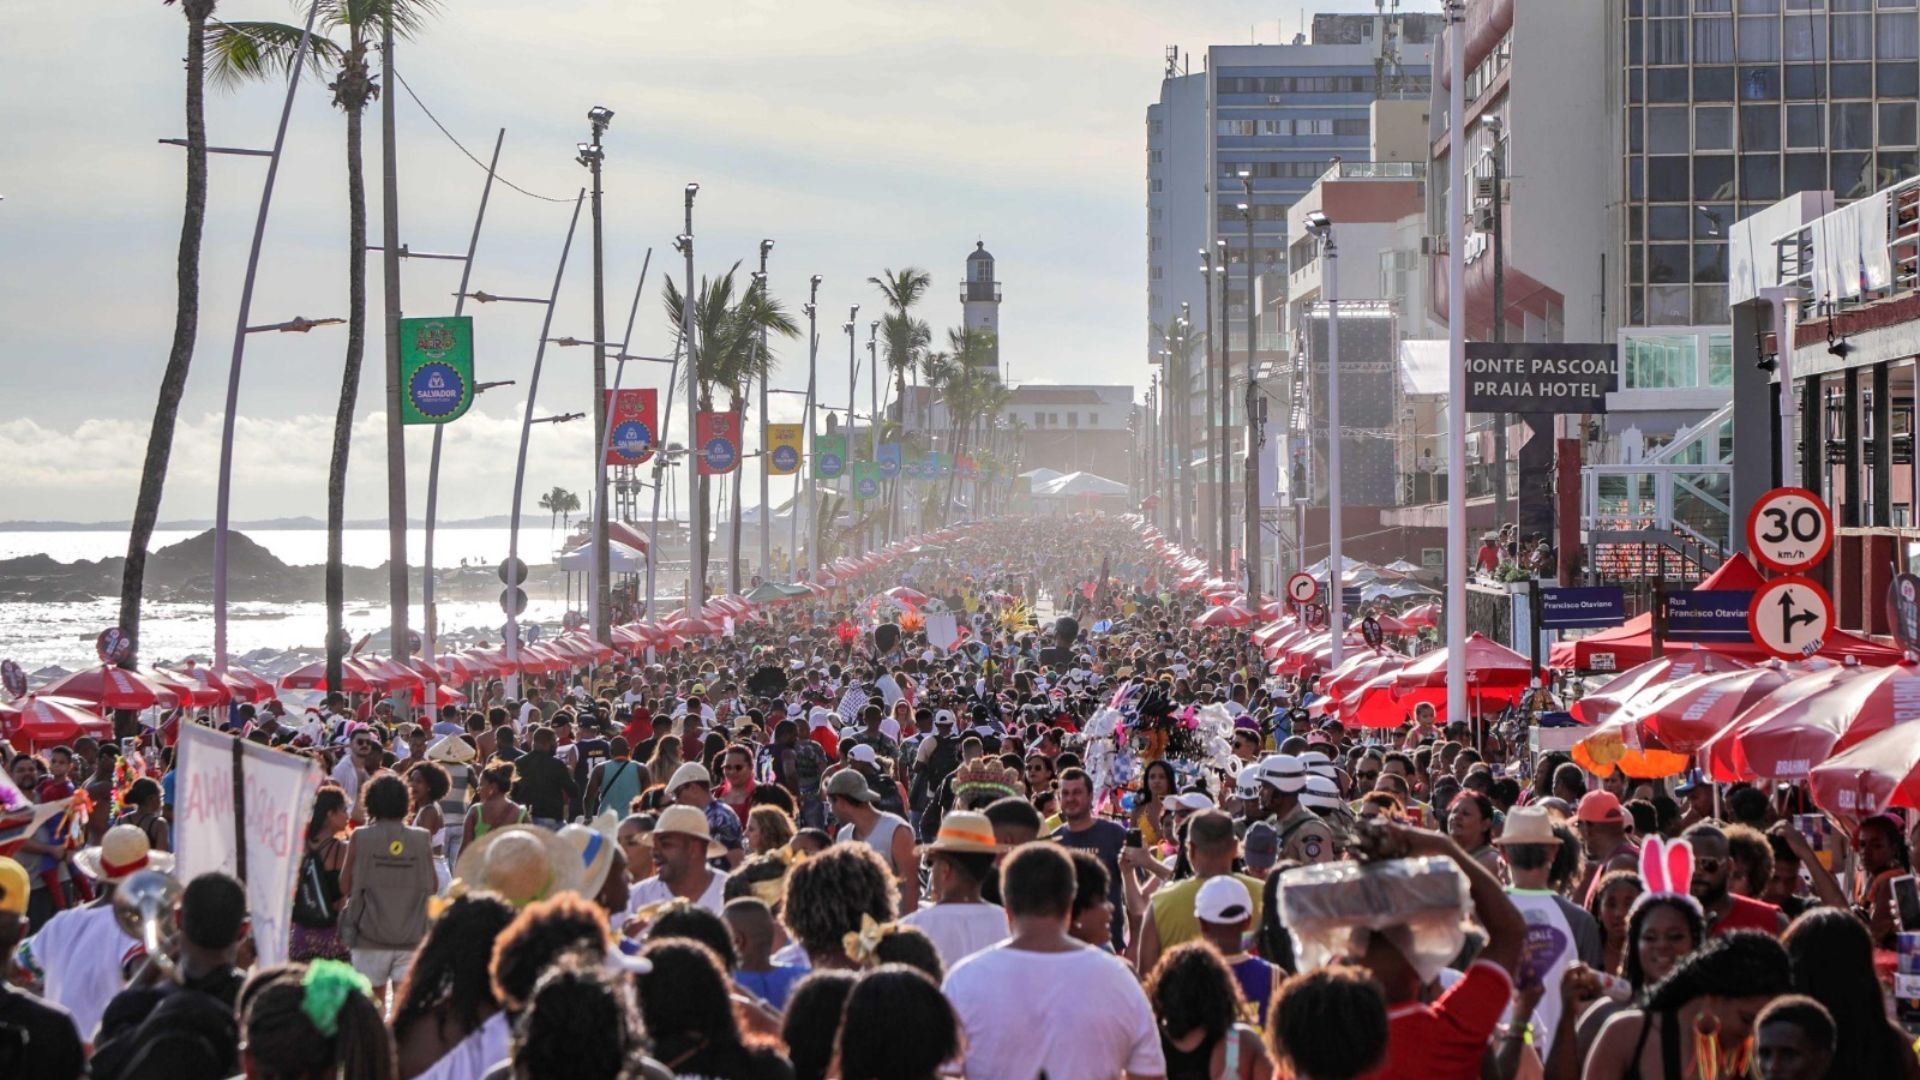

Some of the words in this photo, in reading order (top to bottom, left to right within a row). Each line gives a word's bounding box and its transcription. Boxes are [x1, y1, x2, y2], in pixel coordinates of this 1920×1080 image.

[1532, 359, 1618, 374] PASCOAL
[416, 389, 457, 399] SALVADOR
[1474, 381, 1533, 397] PRAIA
[1540, 382, 1600, 398] HOTEL
[1761, 507, 1821, 543] 30
[1777, 550, 1806, 560] km/h
[1543, 593, 1558, 601] Rua
[1669, 597, 1687, 606] Rua
[1580, 600, 1613, 608] Otaviano
[1669, 608, 1713, 618] Francisco
[1715, 608, 1749, 618] Otavian
